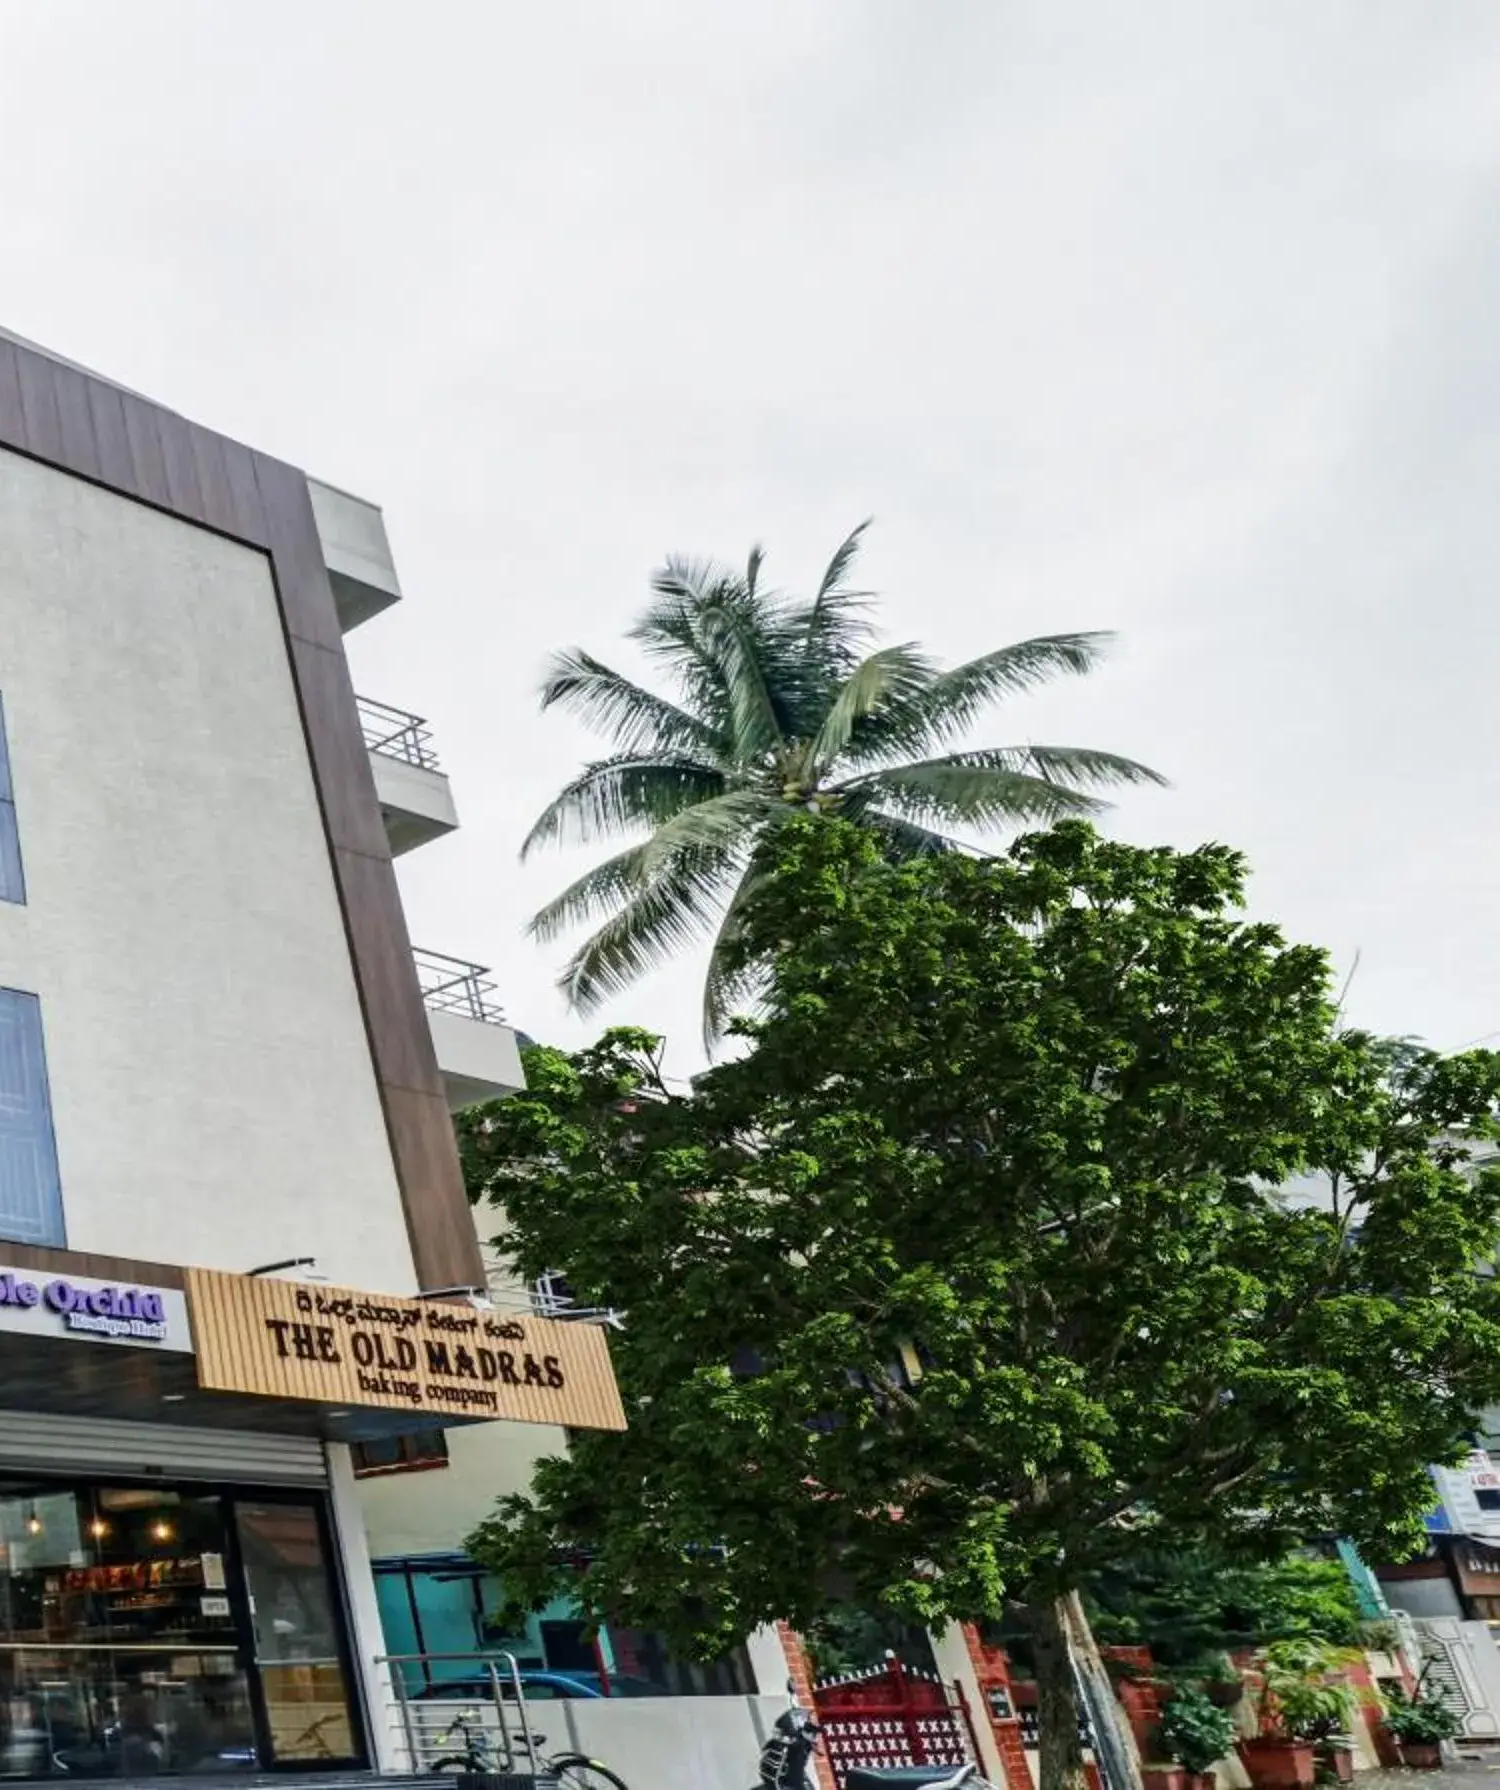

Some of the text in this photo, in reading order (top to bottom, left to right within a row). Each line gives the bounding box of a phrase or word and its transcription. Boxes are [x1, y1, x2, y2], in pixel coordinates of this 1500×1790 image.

[45, 1280, 165, 1322] Orchid
[266, 1319, 565, 1389] THE OLD MADRAS
[357, 1368, 498, 1411] baking company
